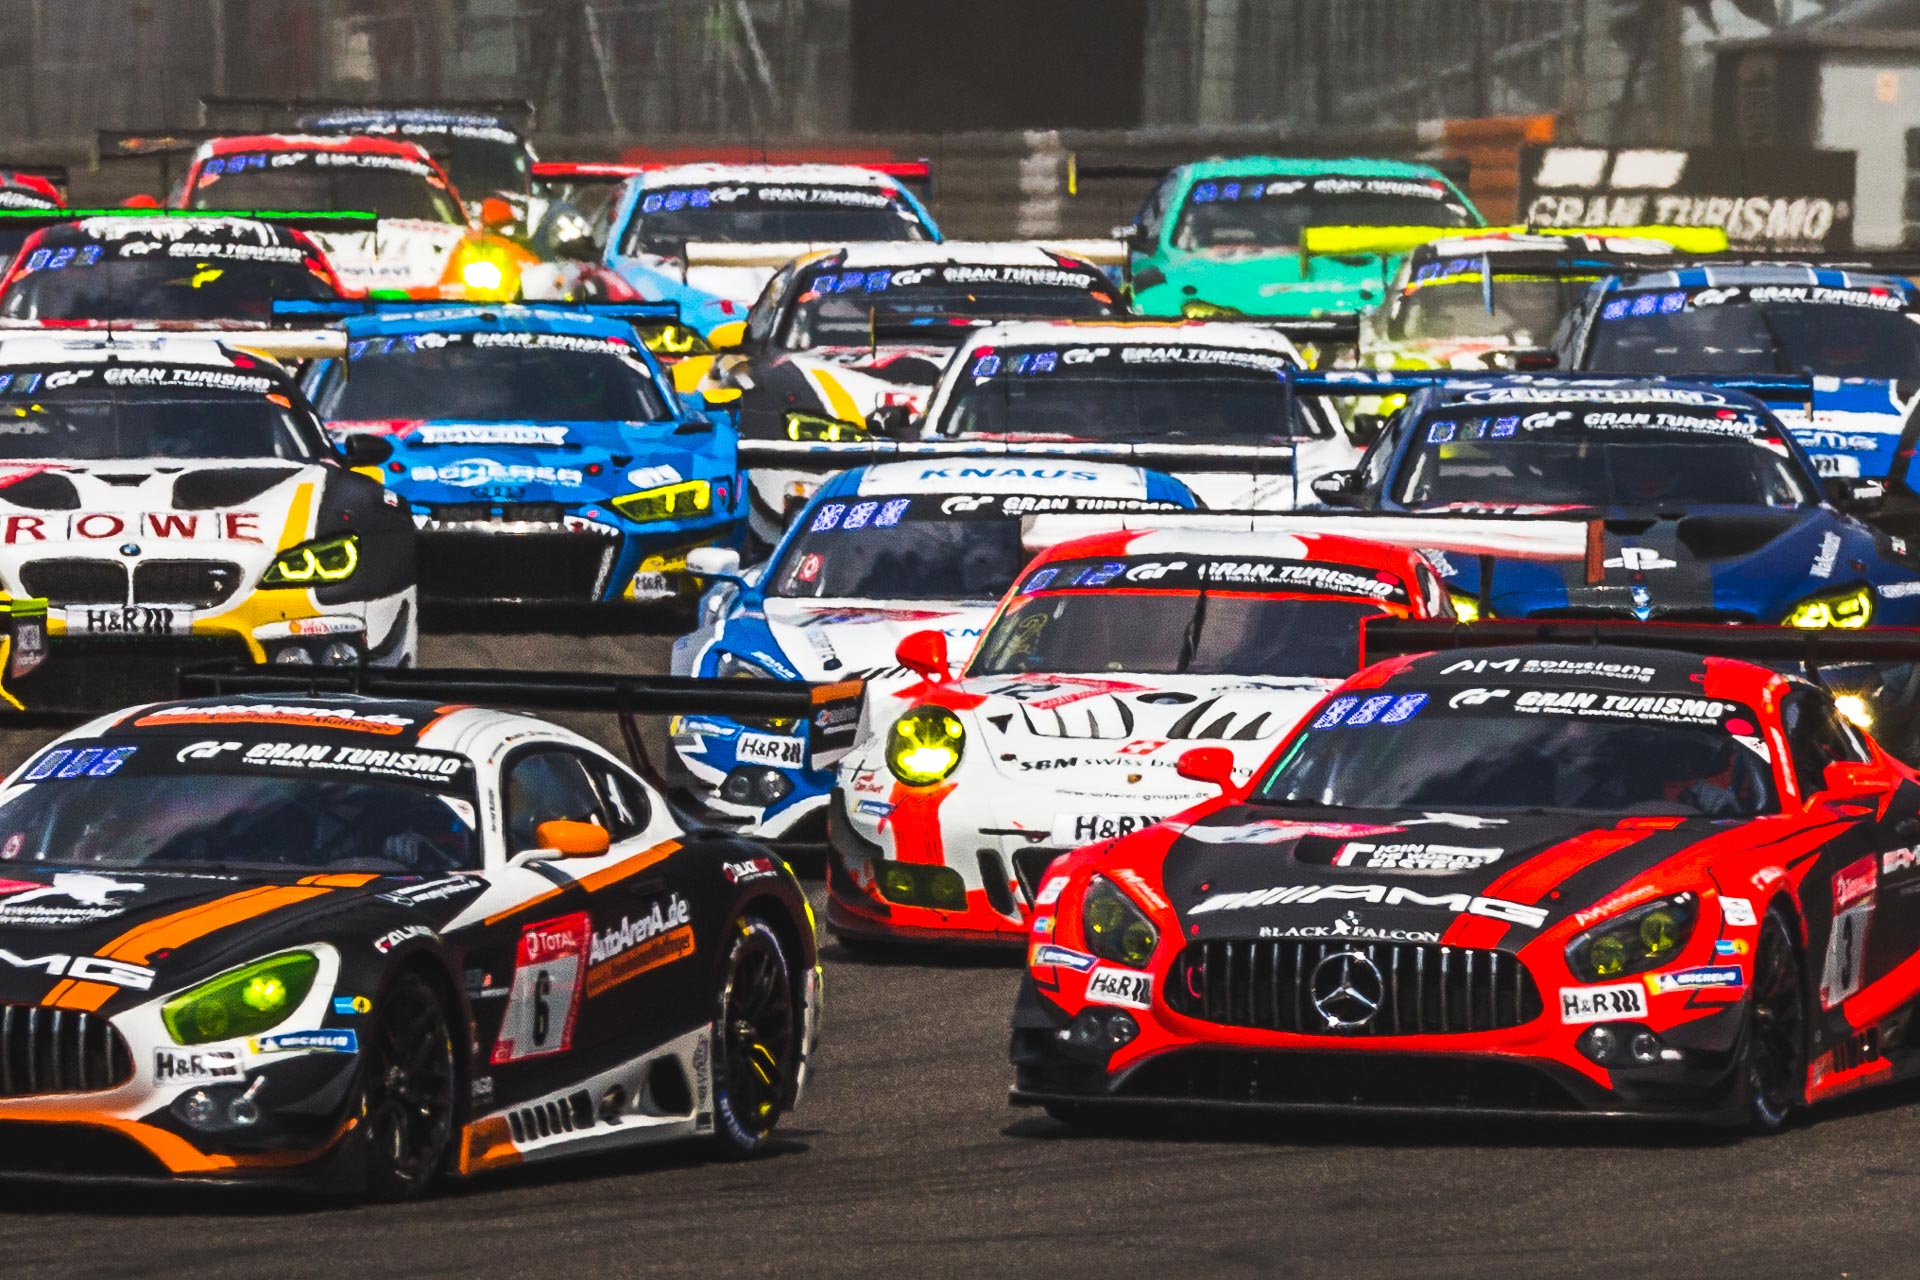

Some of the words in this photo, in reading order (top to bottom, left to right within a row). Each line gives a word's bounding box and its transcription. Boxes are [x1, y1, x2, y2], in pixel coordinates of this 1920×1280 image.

[1527, 194, 1649, 228] GRAN
[1654, 194, 1834, 241] TURISMO
[169, 242, 222, 258] GRAN
[226, 243, 303, 263] TURISMO
[942, 267, 998, 284] GRAN
[1003, 268, 1091, 289] TURISMO
[1749, 286, 1802, 302] GRAN
[1811, 287, 1902, 309] TURISMO
[1121, 347, 1183, 364] GRAN
[1185, 349, 1287, 370] TURISMO
[103, 367, 167, 383] GRAN
[173, 369, 273, 390] TURISMO
[1583, 412, 1650, 427] GRAN
[1656, 413, 1759, 435] TURISMO
[920, 467, 1098, 482] KNAUS
[1003, 496, 1069, 512] GRAN
[4, 513, 265, 545] ROWE
[1198, 561, 1273, 577] GRAN
[1279, 565, 1395, 595] TURISMO
[87, 608, 139, 633] H&R
[1523, 659, 1657, 677] solutions
[1515, 690, 1598, 708] GRAN
[1604, 694, 1724, 718] TURISMO
[244, 742, 325, 762] GRAN
[334, 746, 463, 775] TURISMO
[741, 736, 781, 759] H&R
[1019, 756, 1080, 772] SBM
[1074, 815, 1138, 842] H&R
[1377, 843, 1426, 855] JOIN
[539, 930, 577, 949] TOTAL
[1259, 925, 1329, 938] BLACK
[1352, 926, 1441, 943] FALCON
[1090, 972, 1132, 997] H&R
[532, 969, 550, 1047] 6
[1562, 993, 1608, 1016] H&R
